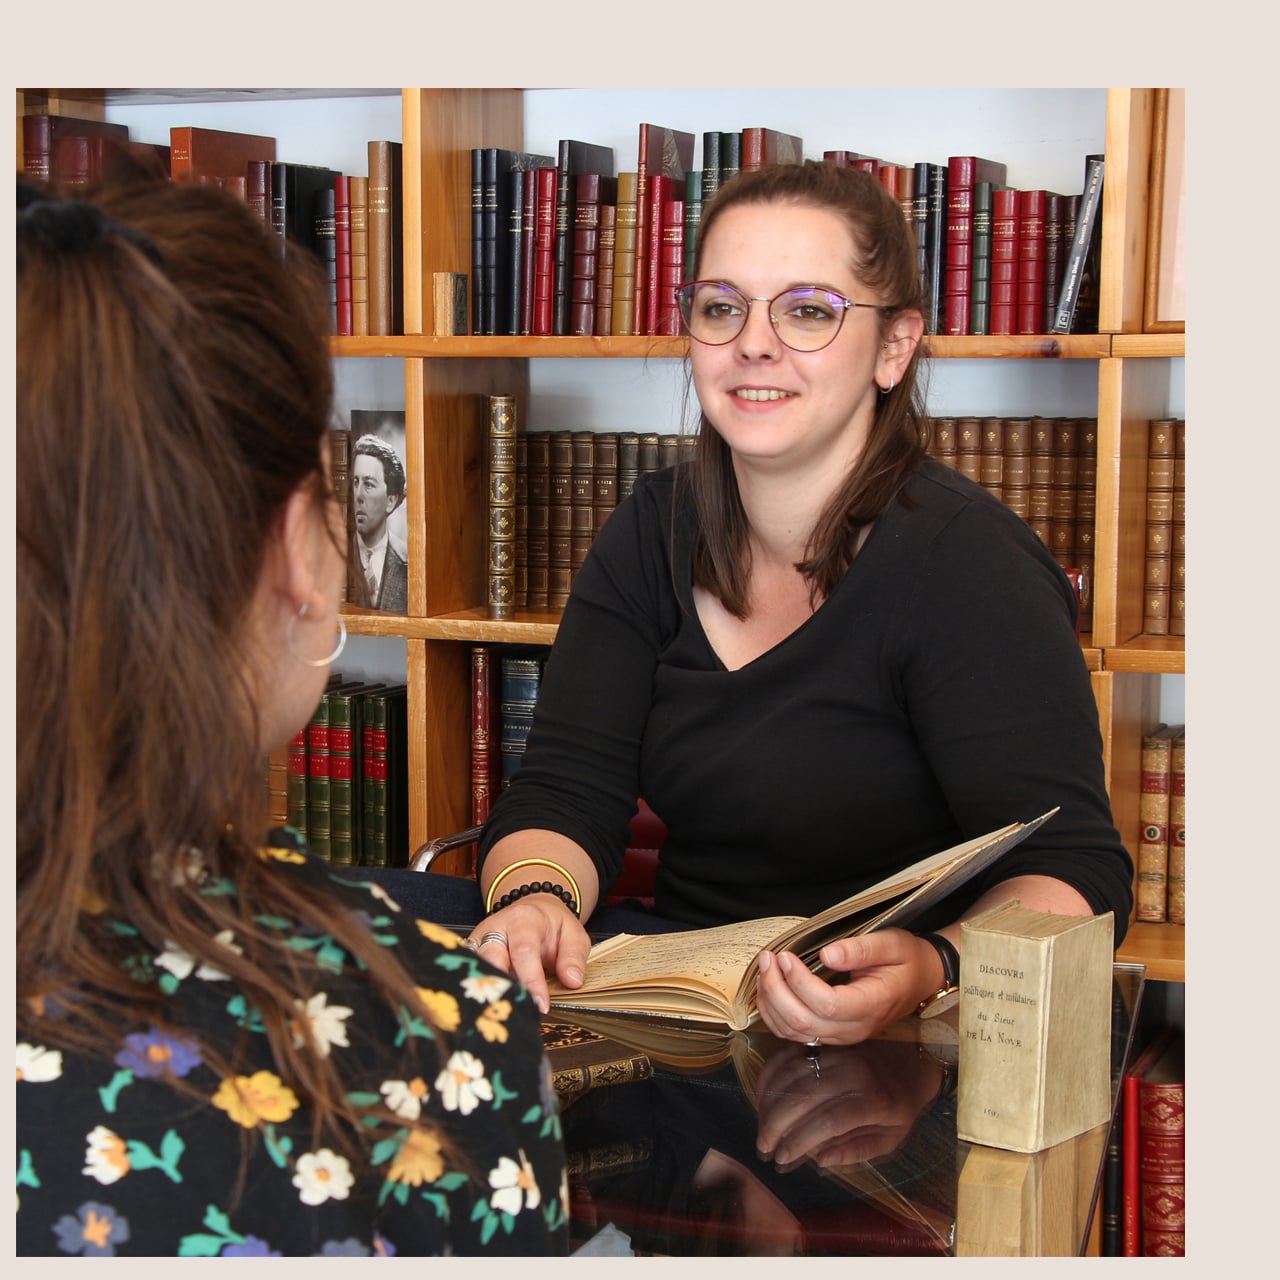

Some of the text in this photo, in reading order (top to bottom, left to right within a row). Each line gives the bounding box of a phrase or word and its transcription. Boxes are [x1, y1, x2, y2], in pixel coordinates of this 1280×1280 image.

[979, 964, 1025, 980] DISCOVRS
[977, 1011, 1016, 1025] du Sieur
